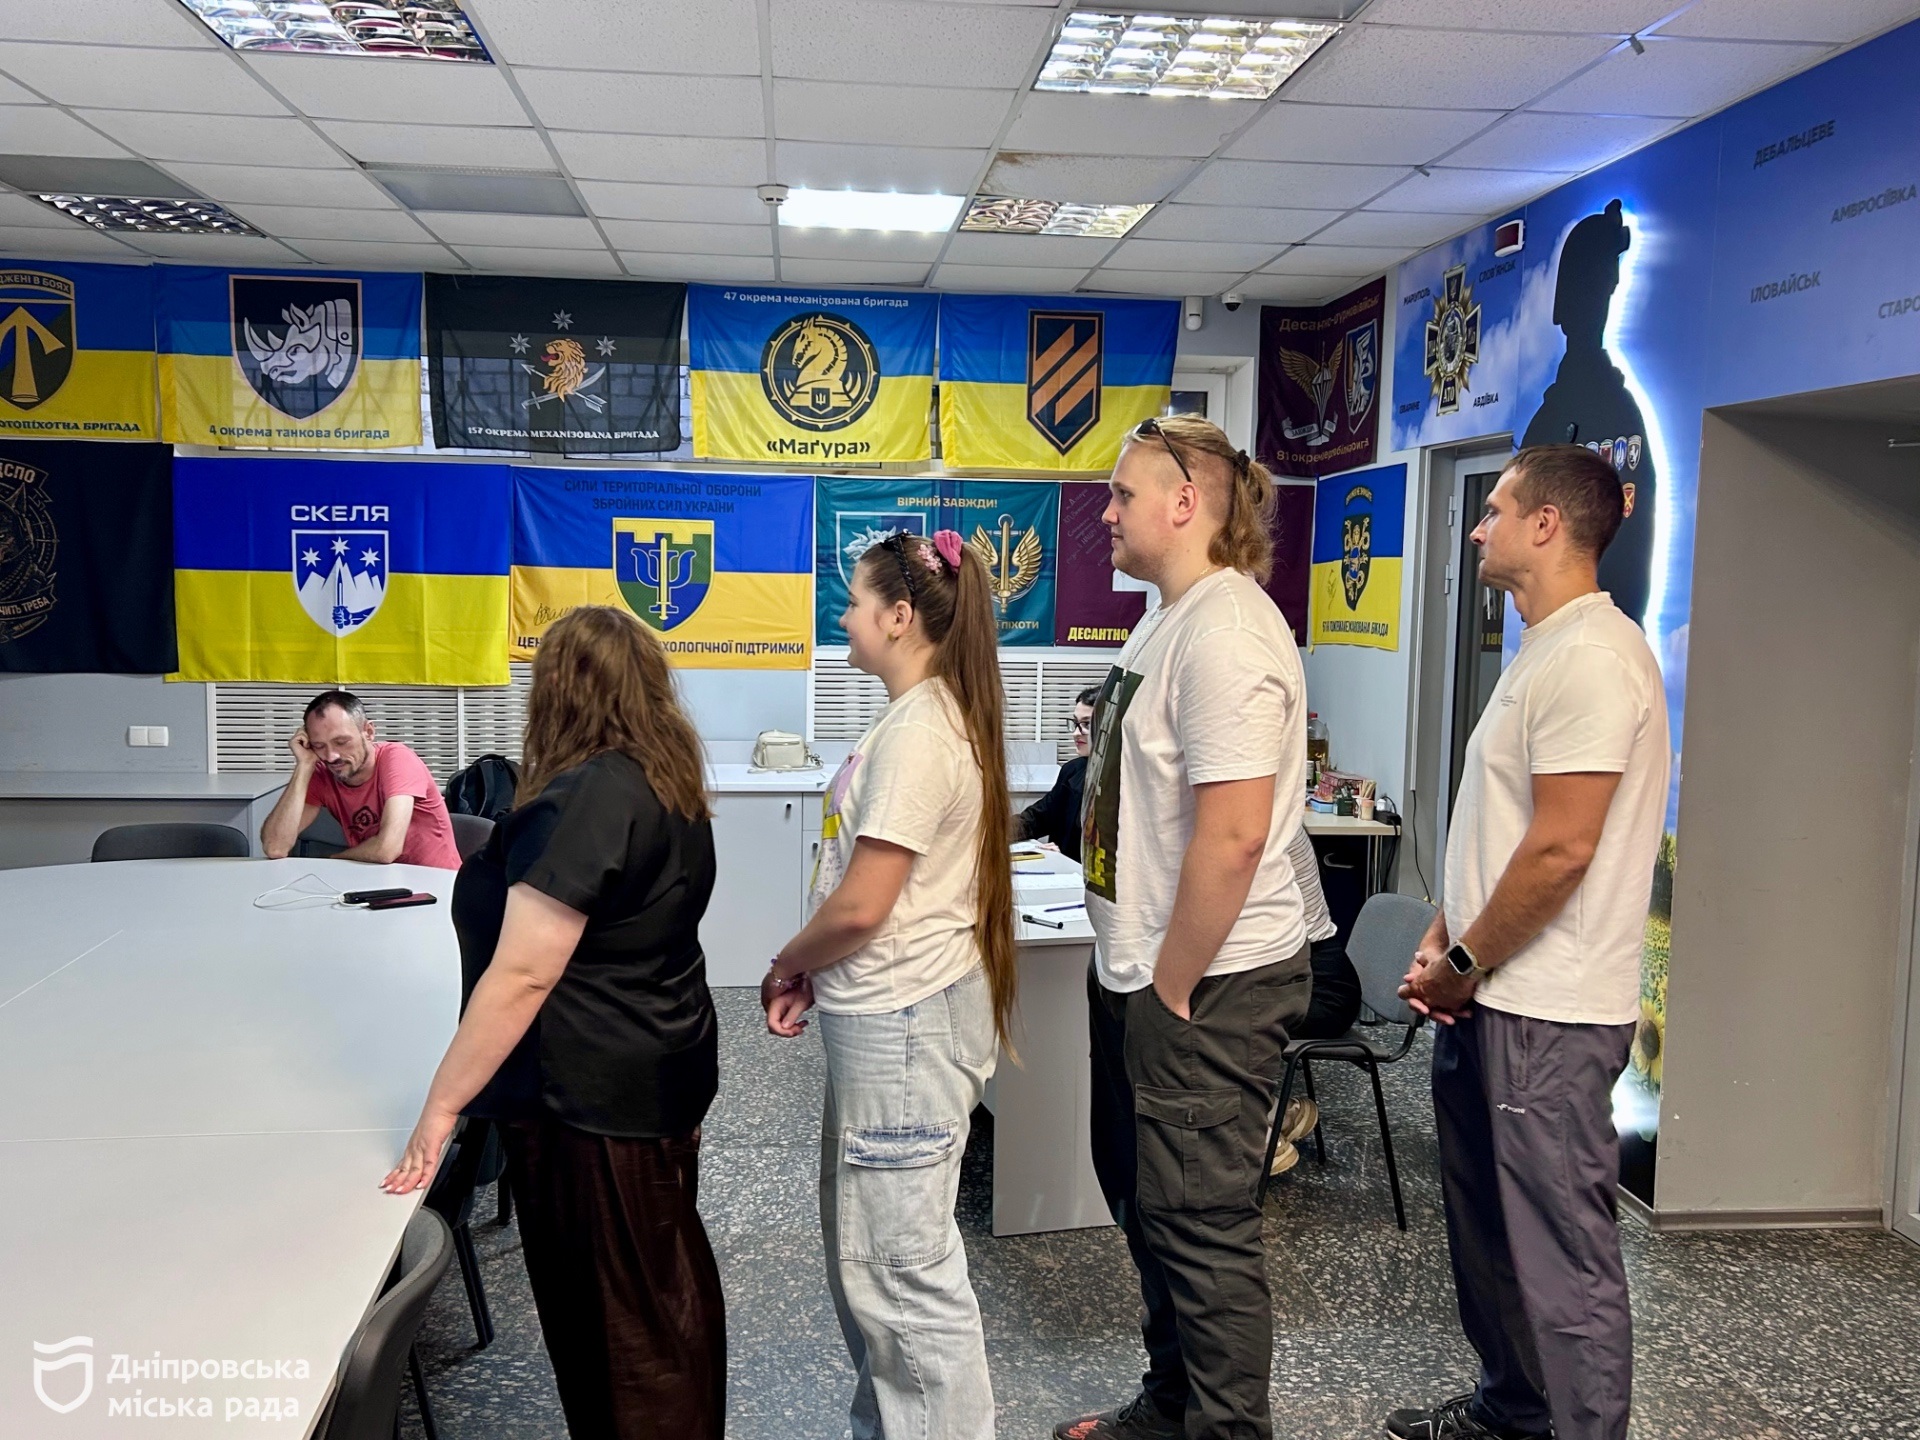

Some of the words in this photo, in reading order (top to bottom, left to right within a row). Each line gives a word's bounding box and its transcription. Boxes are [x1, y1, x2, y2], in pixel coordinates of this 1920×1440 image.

[1753, 119, 1835, 170] ДЕБАЛЬЦЕВЕ
[33, 276, 41, 285] В
[42, 279, 70, 293] БОЯХ
[1750, 271, 1821, 303] ІЛОВАЙСЬК
[723, 291, 738, 301] 47
[739, 294, 781, 305] окрема
[783, 294, 861, 307] механізована
[863, 296, 909, 308] бригада
[83, 422, 141, 432] БРИГАДА
[209, 425, 217, 436] 4
[219, 427, 273, 440] окрема
[274, 428, 332, 440] танкова
[333, 427, 391, 440] бригада
[467, 426, 483, 436] 157
[485, 428, 529, 438] ОКРЕМА
[530, 429, 612, 440] МЕХАНІЗОВАНА
[614, 431, 660, 440] БРИГАДА
[766, 438, 871, 458] «Маґура»
[1276, 450, 1289, 461] 81
[565, 480, 598, 492] СИЛИ
[603, 480, 701, 496] ТЕРИТОРІАЛЬНОЇ
[706, 484, 762, 497] ОБОРОНИ
[593, 497, 655, 511] ЗБРОЙНИХ
[658, 500, 683, 512] СИЛ
[686, 500, 735, 514] УКРАЇНИ
[897, 495, 941, 508] ВІРНИЙ
[944, 497, 998, 509] ЗАВЖДИ!
[290, 504, 390, 522] СКЕЛЯ
[21, 596, 51, 612] ТРЕБА
[1001, 620, 1040, 630] ПІХОТИ
[517, 636, 543, 649] ЦЕН
[661, 640, 734, 653] ХОЛОГІЧНОЇ
[735, 642, 805, 656] ПІДТРИМКИ
